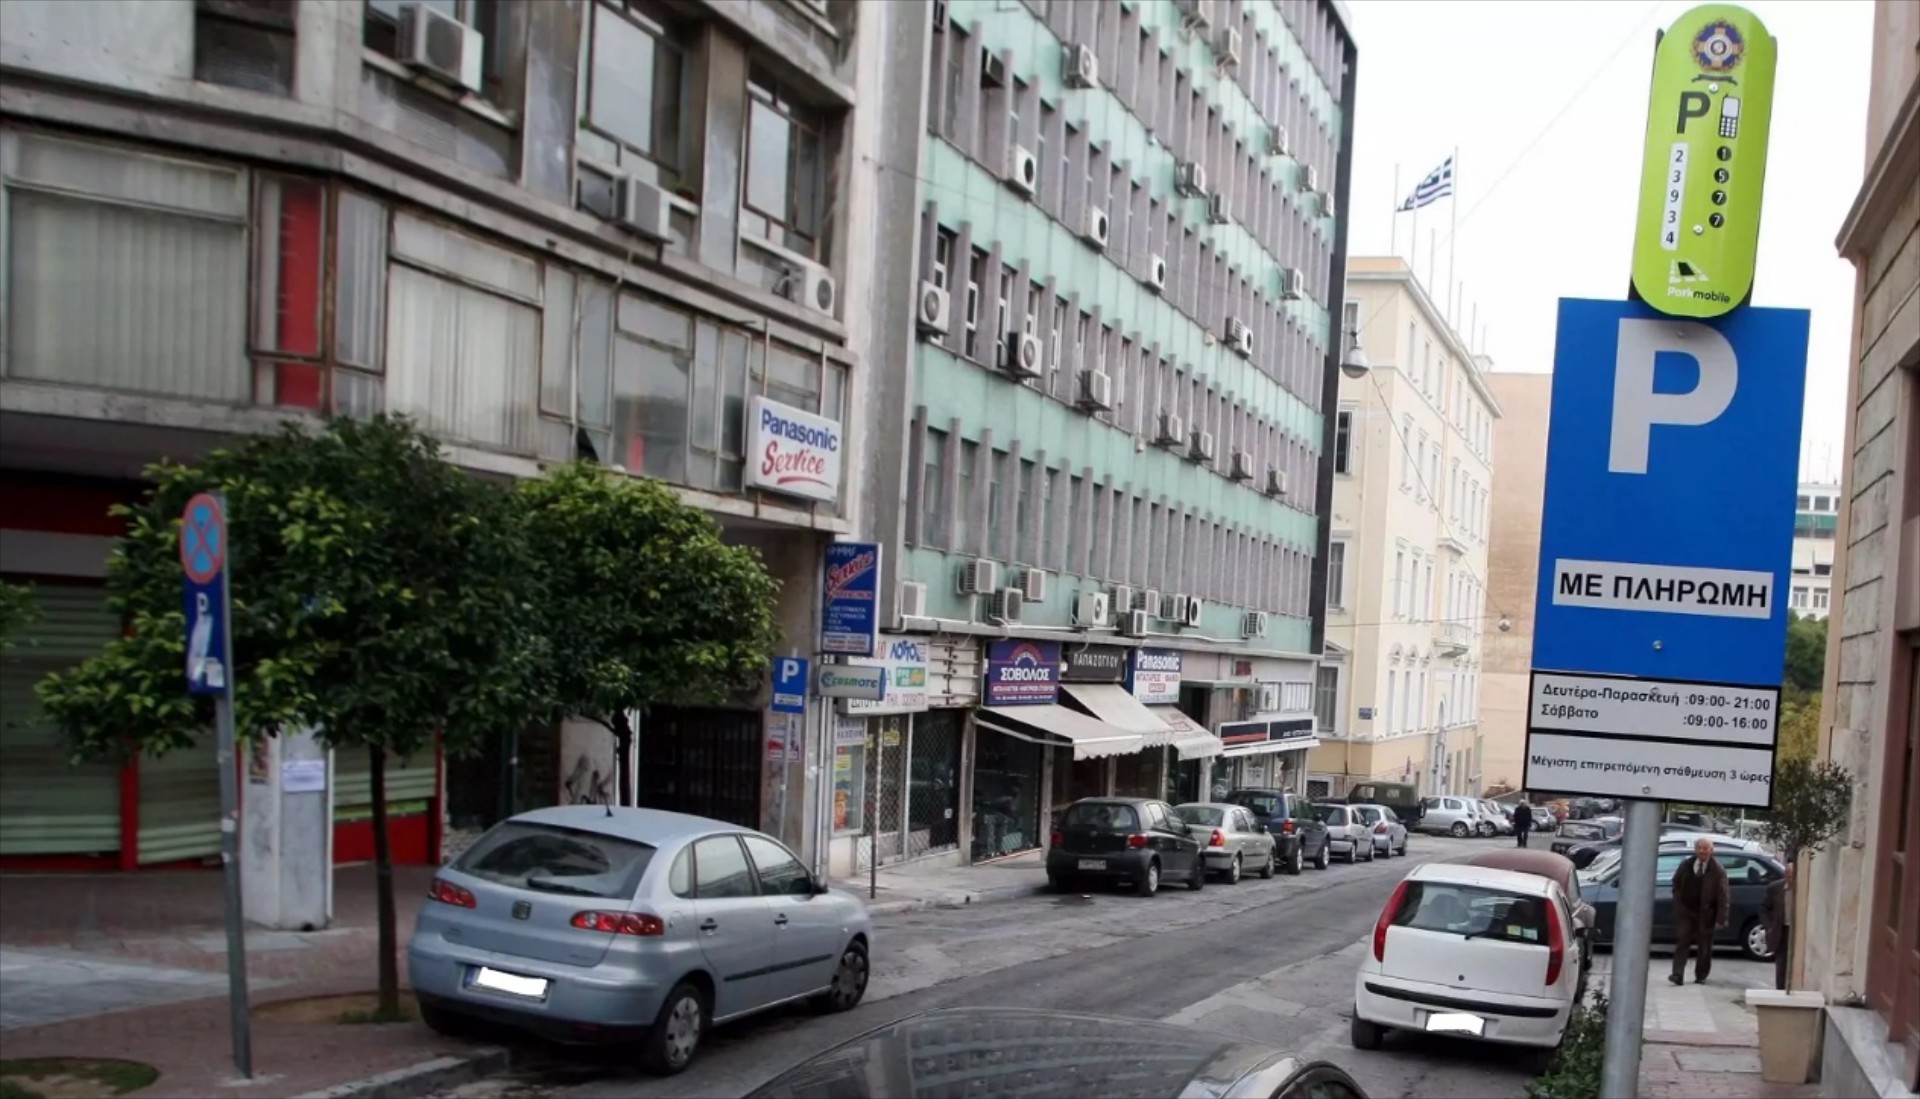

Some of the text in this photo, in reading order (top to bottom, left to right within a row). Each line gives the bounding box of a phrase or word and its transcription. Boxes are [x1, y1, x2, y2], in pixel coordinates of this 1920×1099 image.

[1676, 90, 1711, 134] P
[1607, 318, 1739, 476] P
[761, 408, 838, 453] Panasonic
[761, 440, 826, 477] Service
[1559, 571, 1768, 608] ΜΕ ΠΛΗΡΩΜΗ
[781, 659, 800, 684] P
[1000, 667, 1051, 681] ΣΟΒΟΛΟΣ
[1073, 653, 1119, 668] ΠΑΠΑΖΟΓΛΟΥ
[1137, 650, 1180, 671] Panasonic
[1542, 683, 1680, 707] Δευτέρα-Παρασκευή
[1733, 696, 1771, 711] 21:00
[1541, 703, 1599, 720] Σάββατο
[1732, 716, 1768, 730] 16:00
[1531, 754, 1771, 785] Μέγιστη επιτρεπόμενη στάθμευση 3 ώρες
